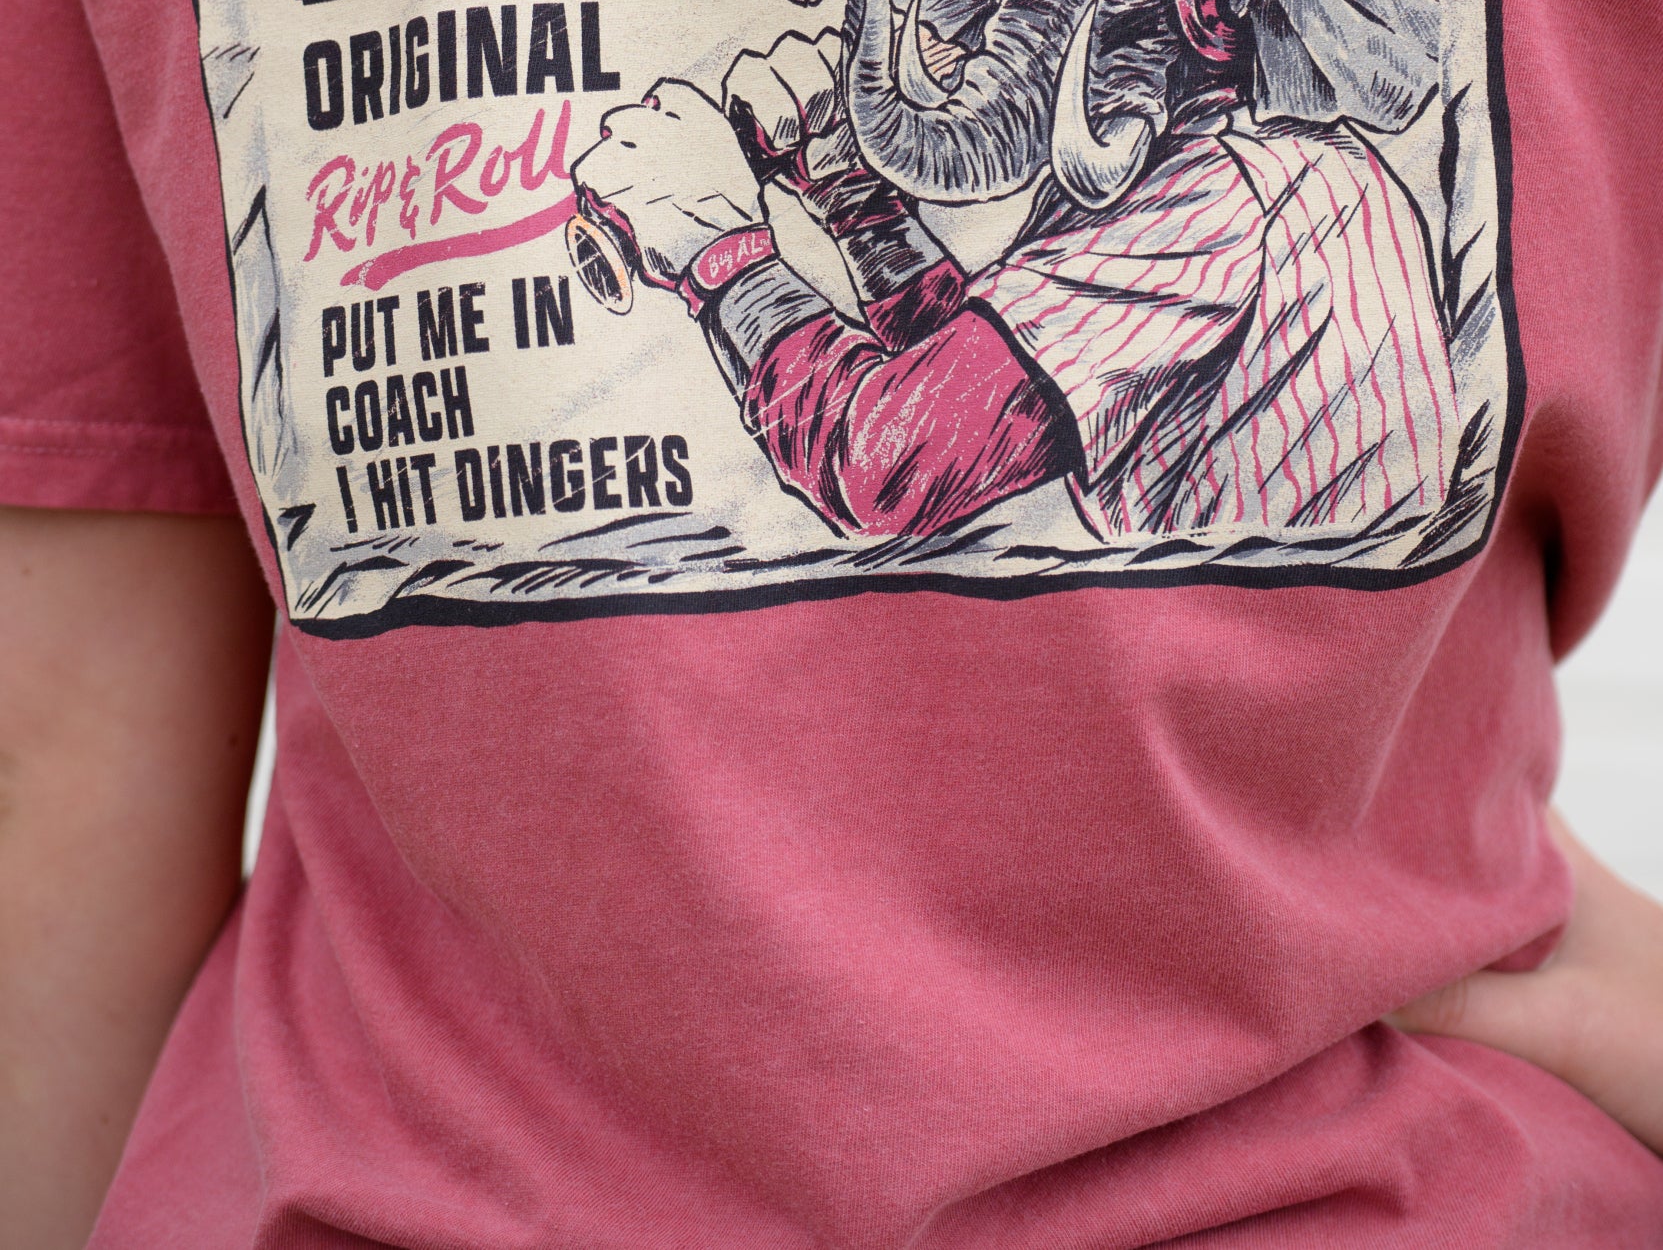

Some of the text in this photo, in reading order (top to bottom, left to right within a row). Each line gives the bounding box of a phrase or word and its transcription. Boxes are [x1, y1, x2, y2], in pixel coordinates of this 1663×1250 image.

[303, 1, 621, 131] ORIGINAL
[321, 275, 576, 377] PUT ME IN
[326, 365, 475, 455] COACH
[336, 434, 694, 534] I HIT DINGERS
